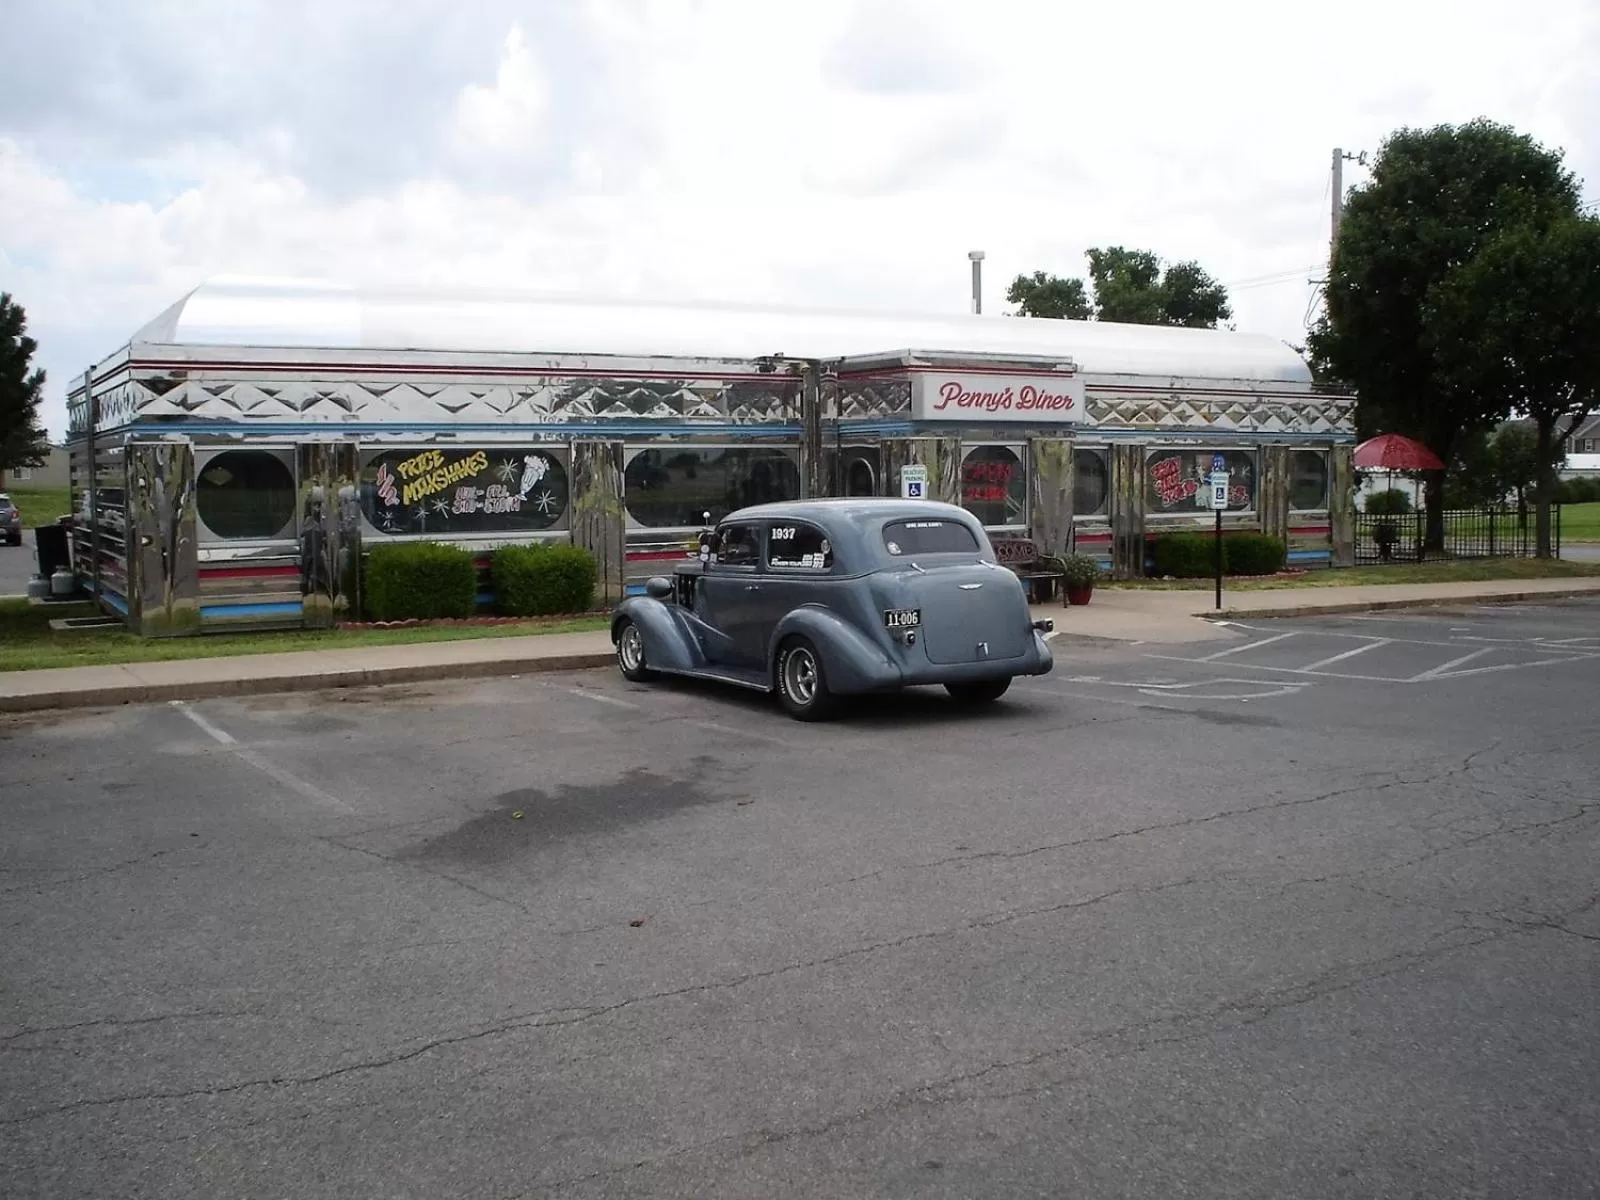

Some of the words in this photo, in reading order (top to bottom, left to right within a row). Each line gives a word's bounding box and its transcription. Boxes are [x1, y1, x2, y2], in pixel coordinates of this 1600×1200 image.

[934, 382, 1013, 412] Penny's
[1016, 385, 1075, 410] Diner
[397, 450, 445, 479] PRICE
[403, 451, 488, 505] MILKSHAKES
[771, 528, 796, 540] 1937
